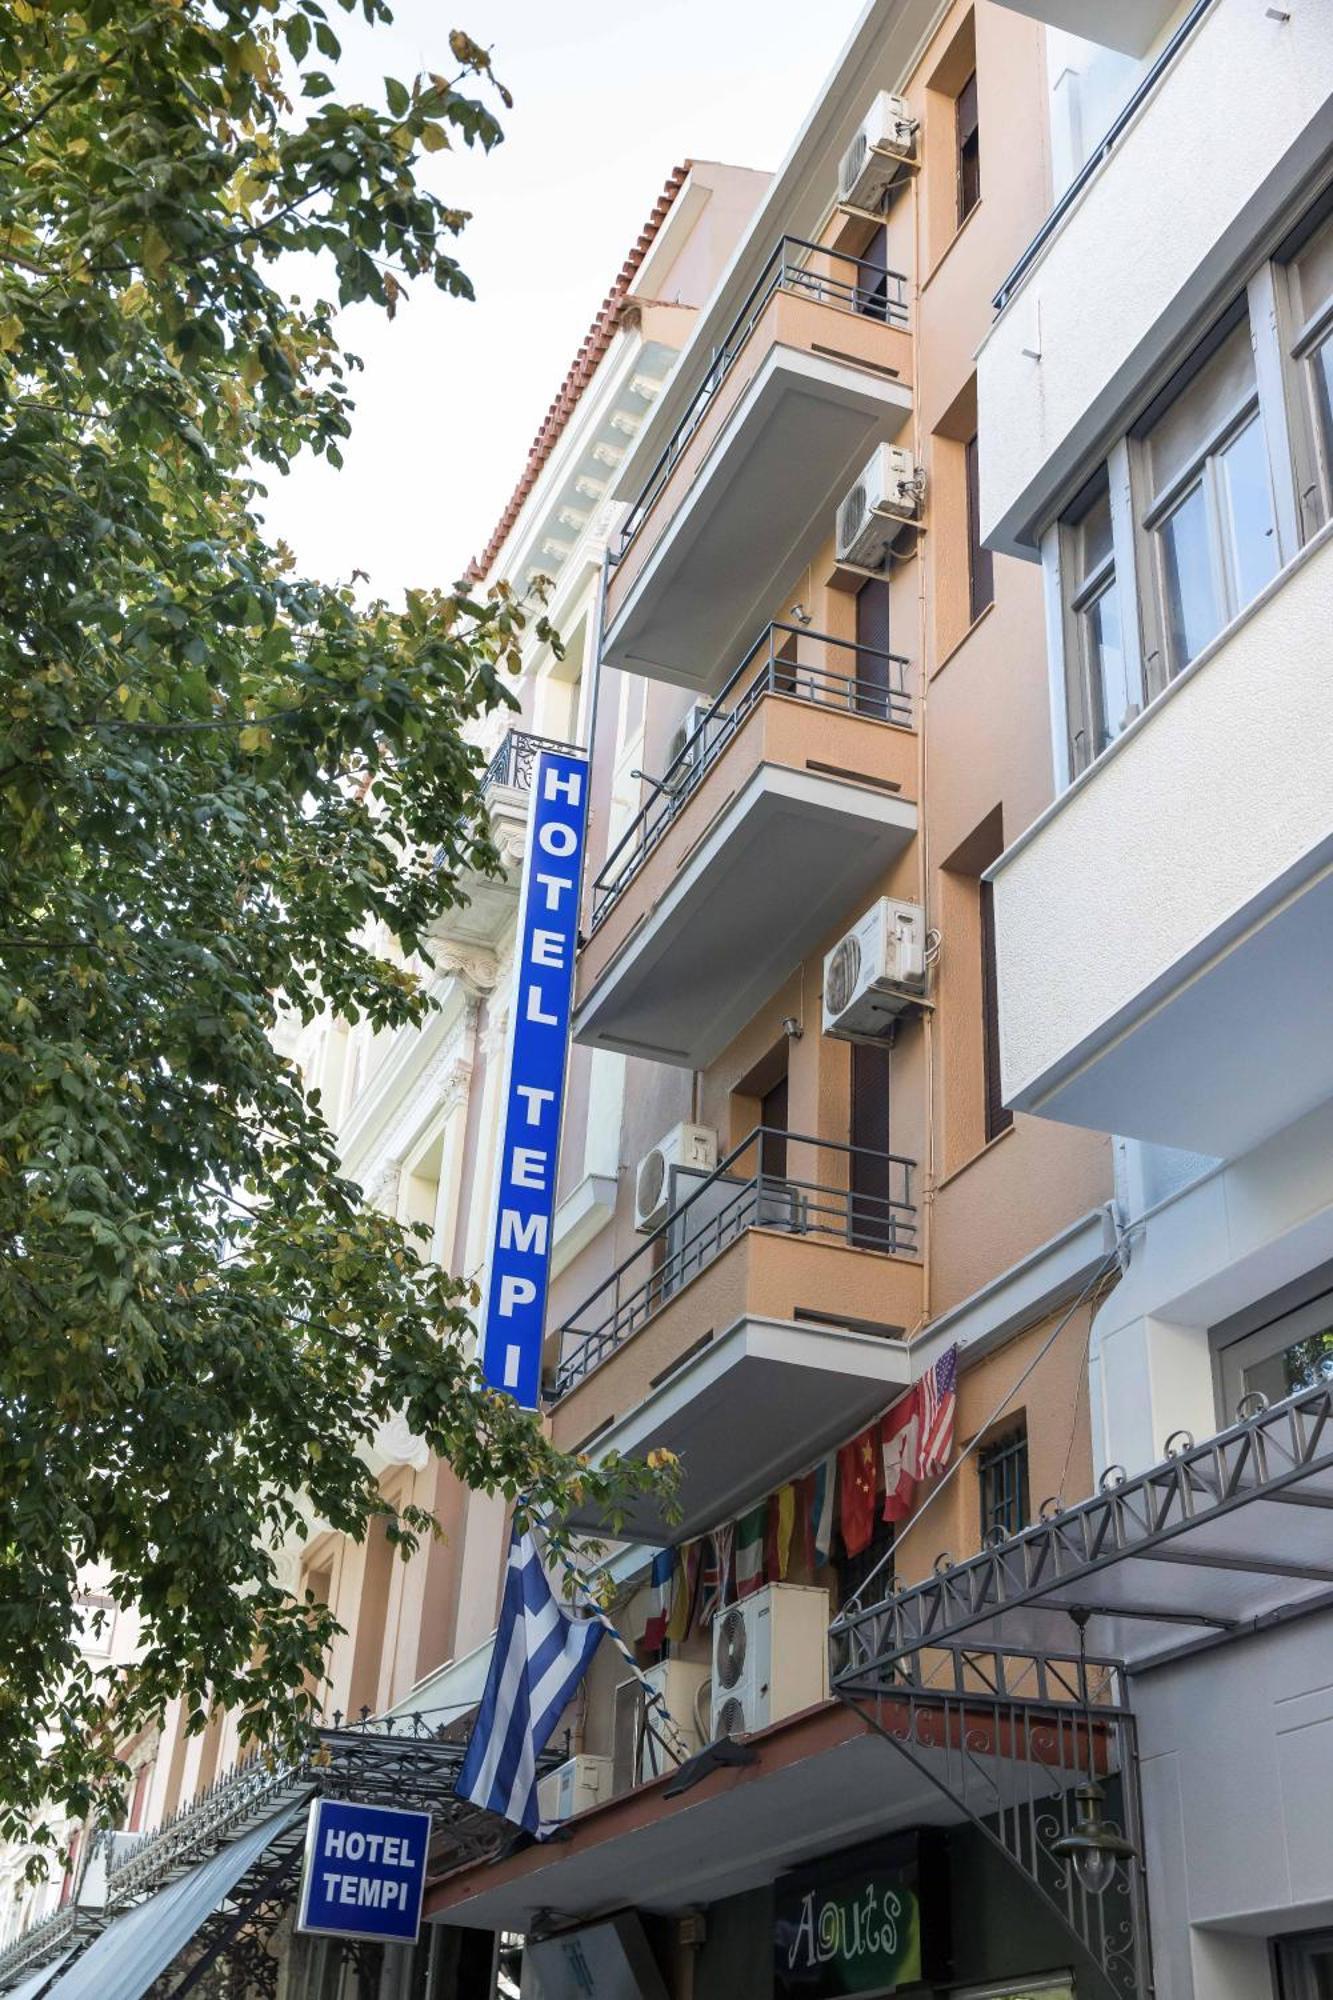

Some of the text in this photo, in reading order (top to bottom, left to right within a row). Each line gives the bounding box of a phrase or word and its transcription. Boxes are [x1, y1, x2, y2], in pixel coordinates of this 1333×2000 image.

[498, 766, 582, 1389] HOTEL TEMPI
[324, 1829, 416, 1868] HOTEL
[322, 1872, 409, 1911] TEMPI
